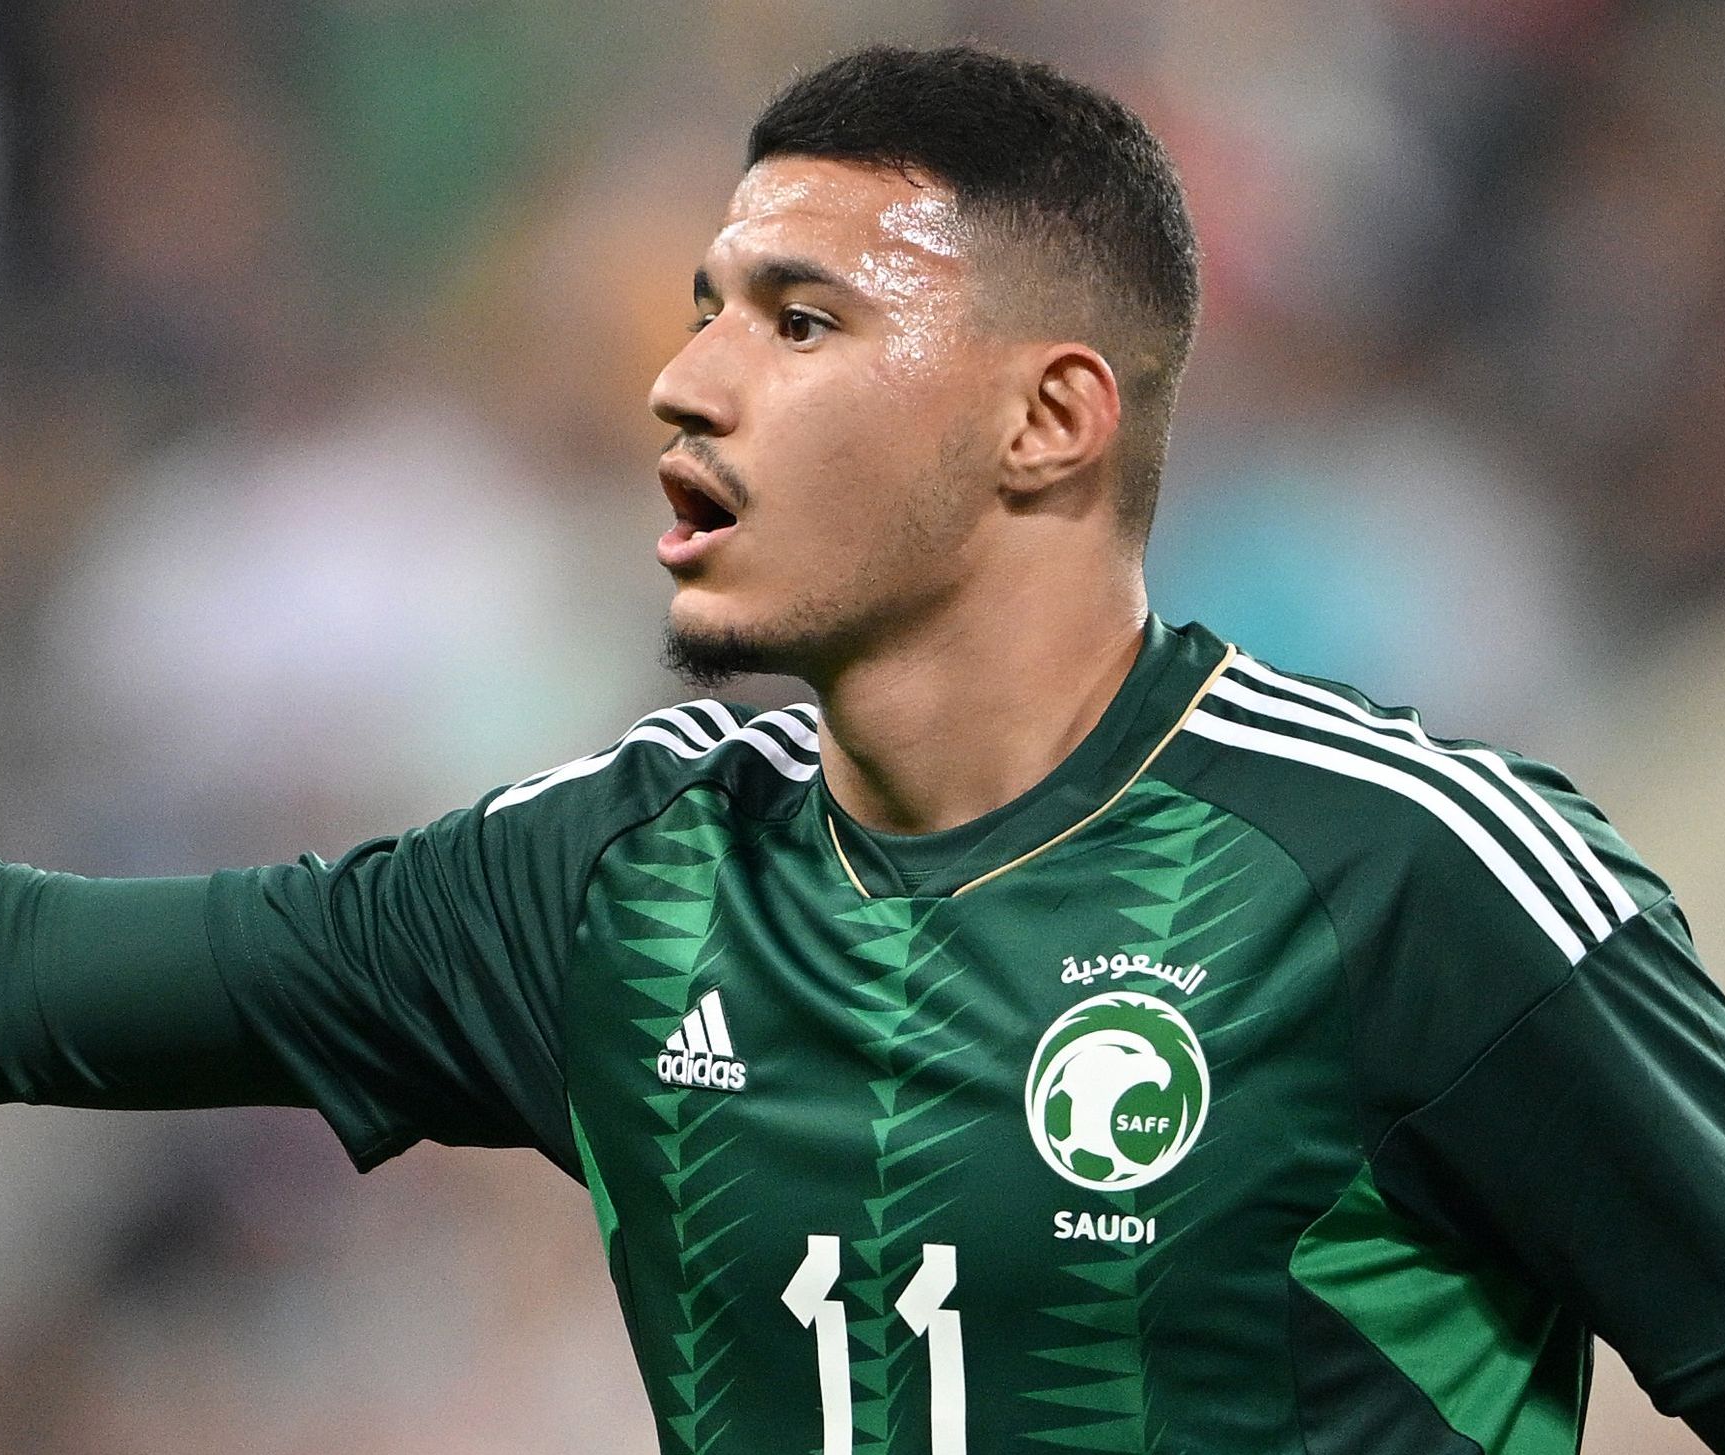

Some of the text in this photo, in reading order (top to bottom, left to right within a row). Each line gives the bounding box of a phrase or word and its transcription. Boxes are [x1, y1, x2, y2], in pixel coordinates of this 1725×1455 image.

[1060, 953, 1208, 996] السعودية
[657, 1048, 747, 1090] adidas
[1115, 1114, 1171, 1135] SAFF
[1052, 1210, 1156, 1244] SAUDI
